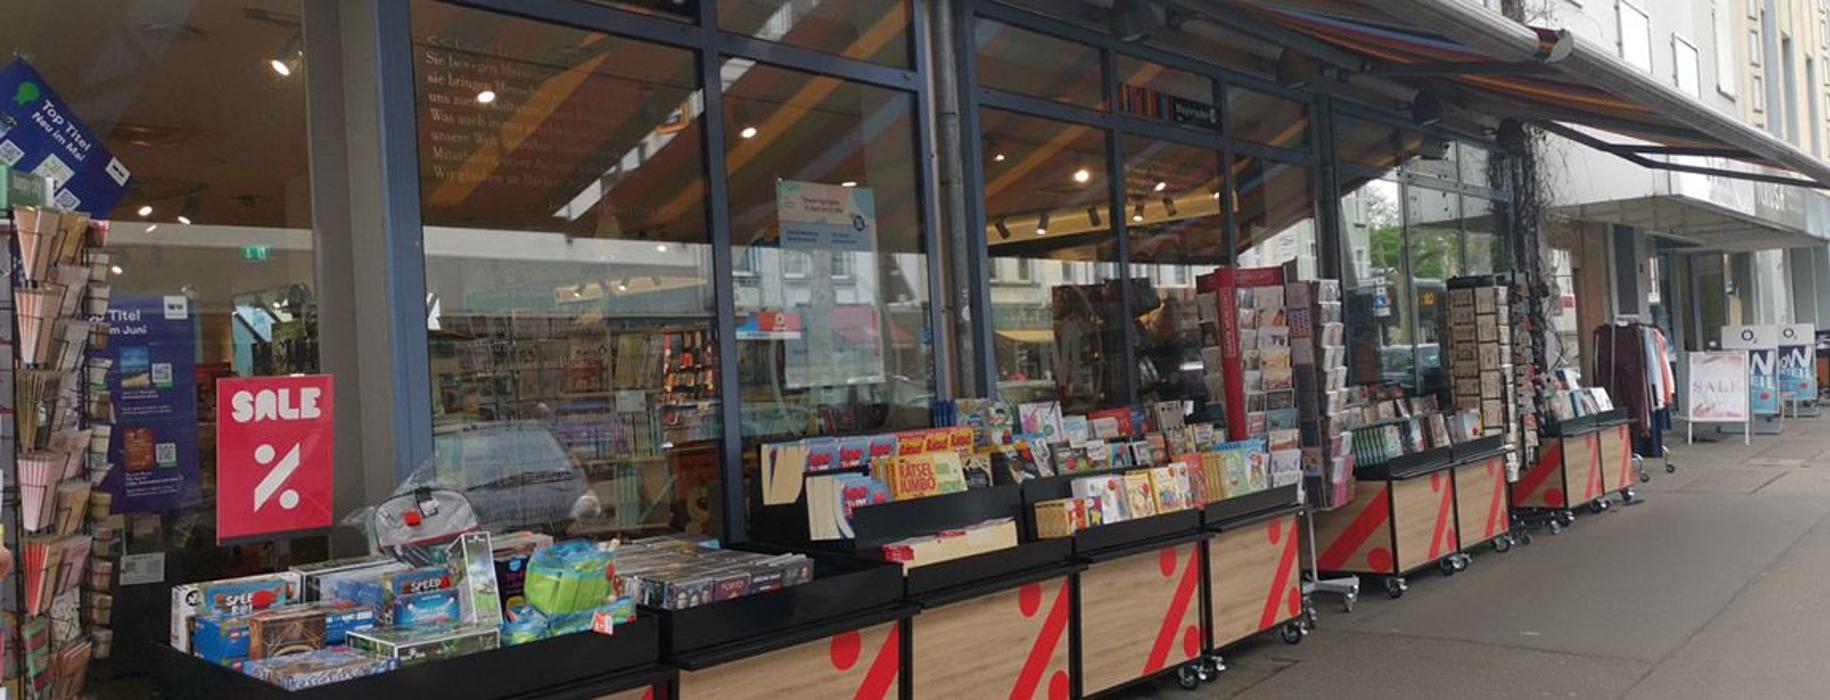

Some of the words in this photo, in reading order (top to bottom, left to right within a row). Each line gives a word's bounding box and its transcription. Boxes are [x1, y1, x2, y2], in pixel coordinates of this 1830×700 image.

[32, 111, 54, 134] Neu
[53, 129, 67, 146] im
[66, 142, 86, 162] Mai
[42, 98, 64, 126] Top
[66, 122, 93, 152] Titel
[108, 308, 141, 322] Titel
[122, 324, 148, 336] Juni
[1692, 380, 1743, 394] SALE
[231, 386, 321, 424] SALE
